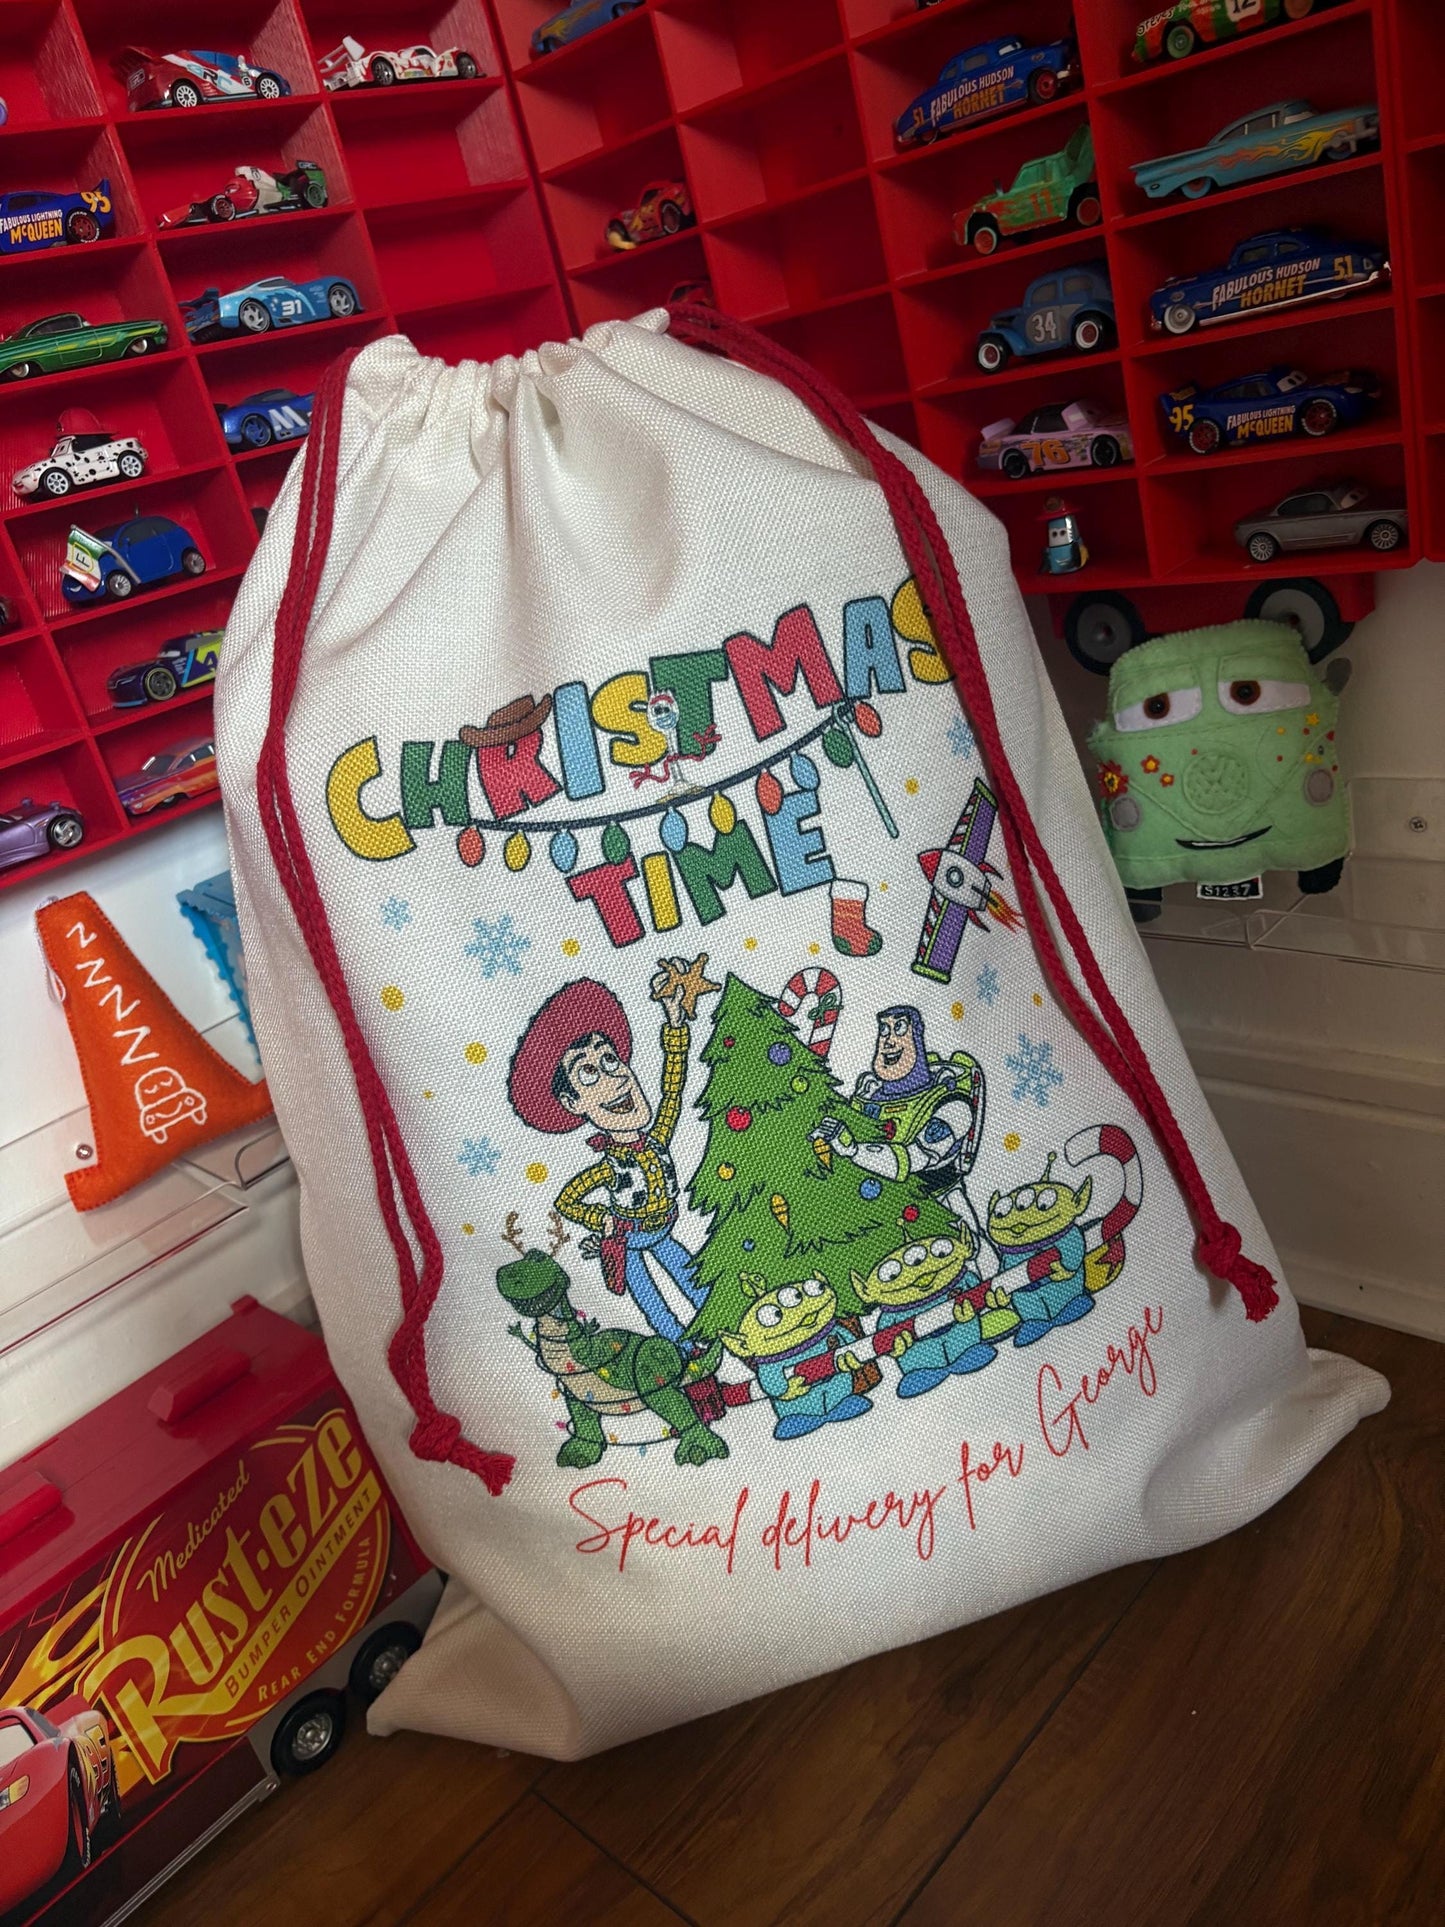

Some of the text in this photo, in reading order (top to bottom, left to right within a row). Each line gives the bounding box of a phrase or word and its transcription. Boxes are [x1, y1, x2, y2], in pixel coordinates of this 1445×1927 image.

[930, 65, 1015, 127] FABULOUS HUDSON
[952, 83, 1005, 119] HORNET
[912, 106, 925, 128] 51
[80, 191, 111, 213] 95
[0, 208, 63, 234] FABULOUS LIGHTNING
[10, 218, 63, 244] McQUEEN
[1332, 254, 1355, 281] 51
[1211, 257, 1321, 312] FABULOUS HUDSON
[1239, 273, 1308, 308] HORNET
[281, 299, 303, 317] 31
[1031, 311, 1057, 342] 34
[1169, 403, 1195, 432] 95
[1226, 407, 1262, 431] FABULOUS
[1262, 404, 1296, 418] LIGHTNING
[1236, 414, 1294, 440] McQUEEN
[1021, 438, 1071, 466] 76
[326, 579, 956, 862] CHRISTMAS
[567, 788, 837, 949] TIME
[567, 1304, 1164, 1573] Special delivery for George
[136, 1459, 250, 1602] Medicated
[224, 1490, 372, 1699] BUMPER OINTMENT
[258, 1537, 371, 1703] REAR END FORMULA
